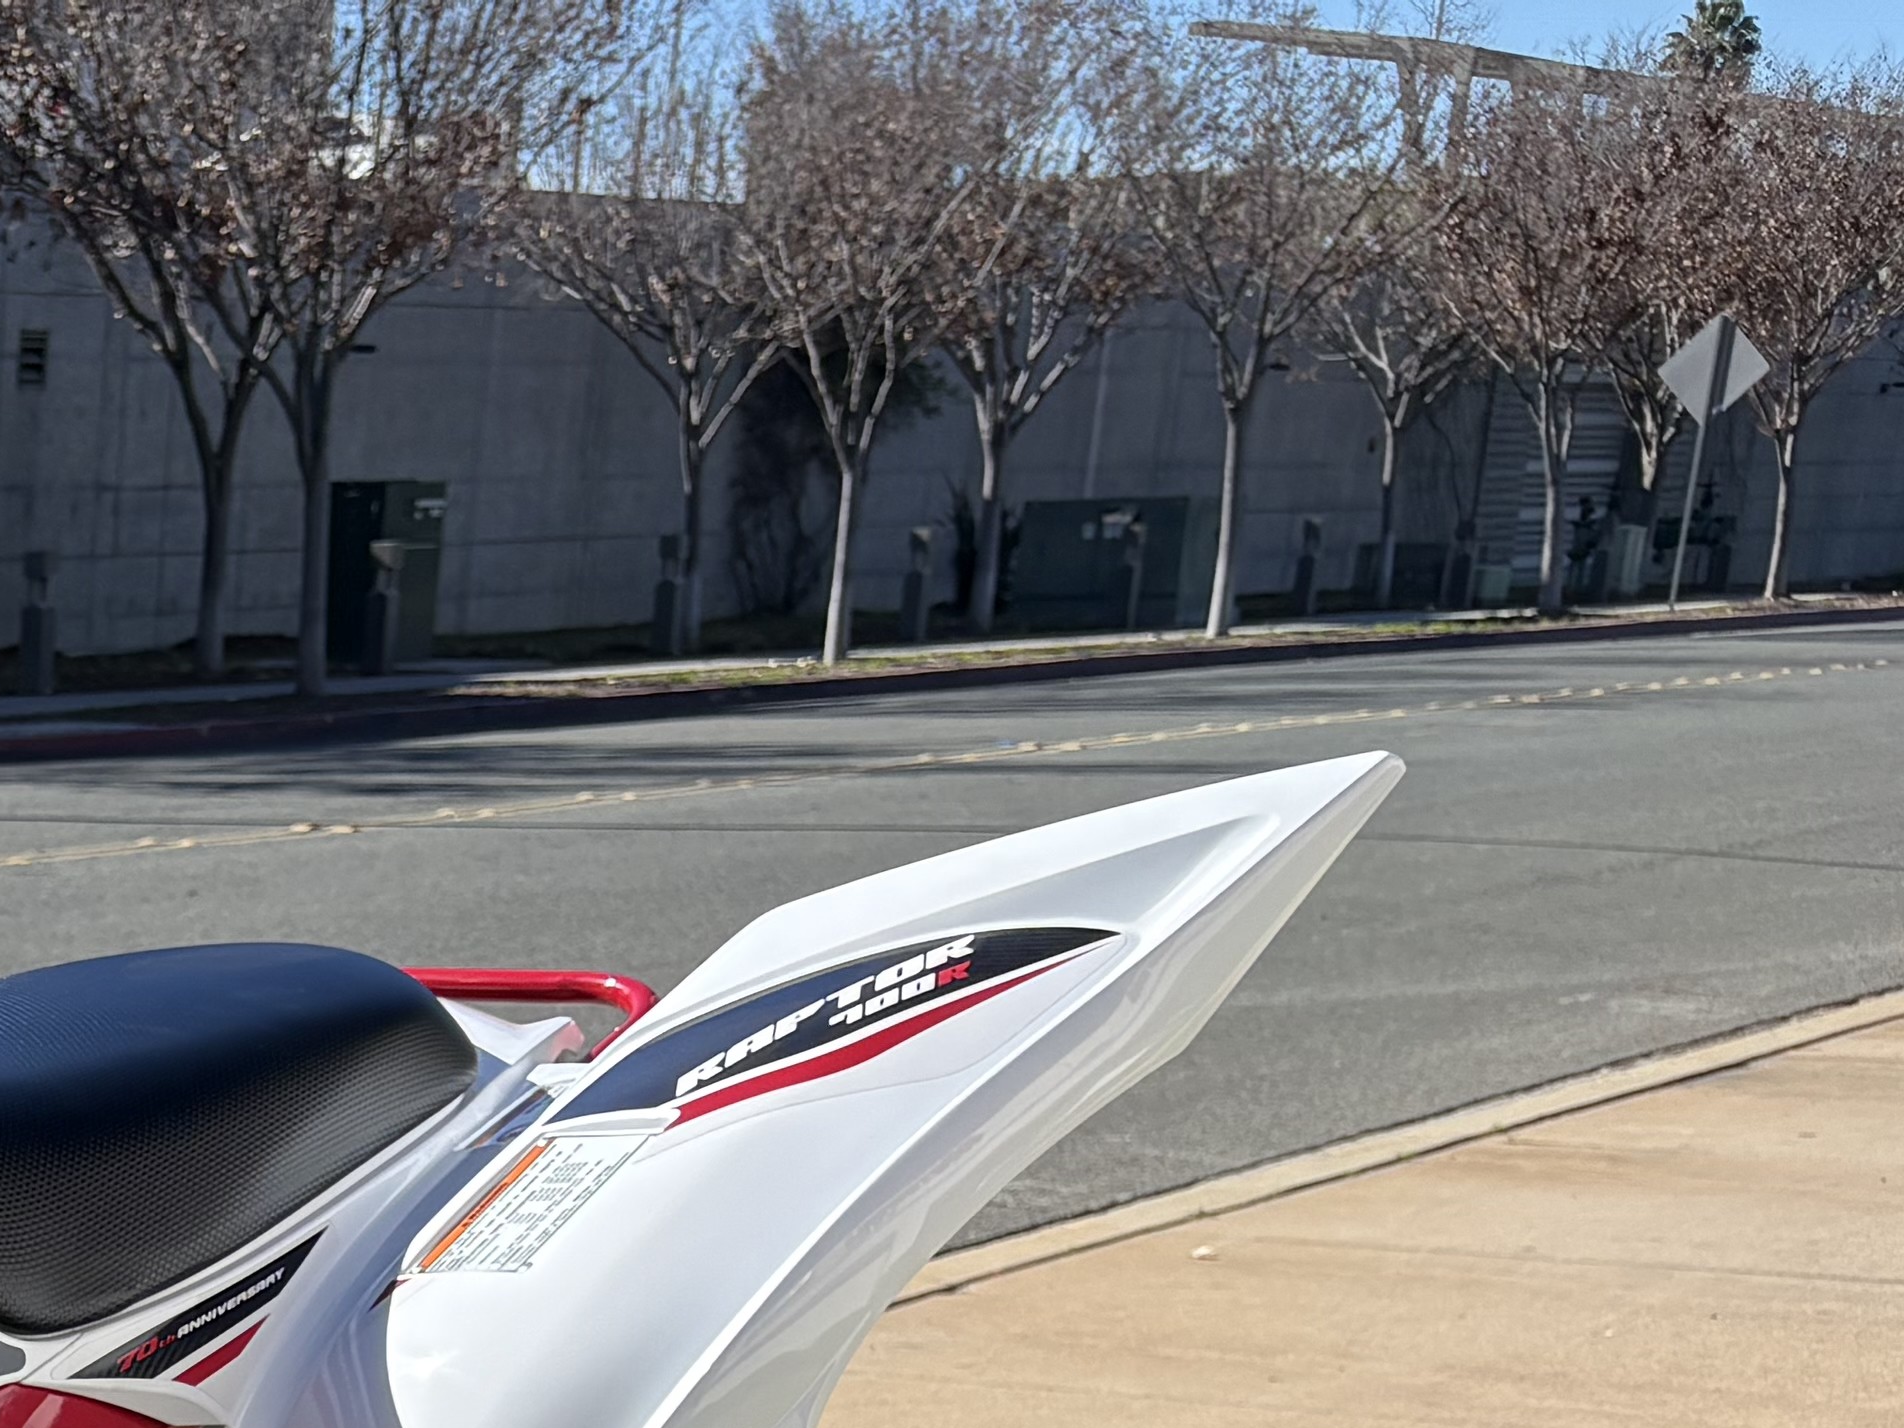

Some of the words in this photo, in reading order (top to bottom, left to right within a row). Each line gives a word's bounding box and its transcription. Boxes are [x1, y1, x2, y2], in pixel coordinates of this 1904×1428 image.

[675, 934, 975, 1098] RAPTOR
[829, 961, 972, 1026] 700R
[176, 1267, 285, 1339] ANNIVERSARY
